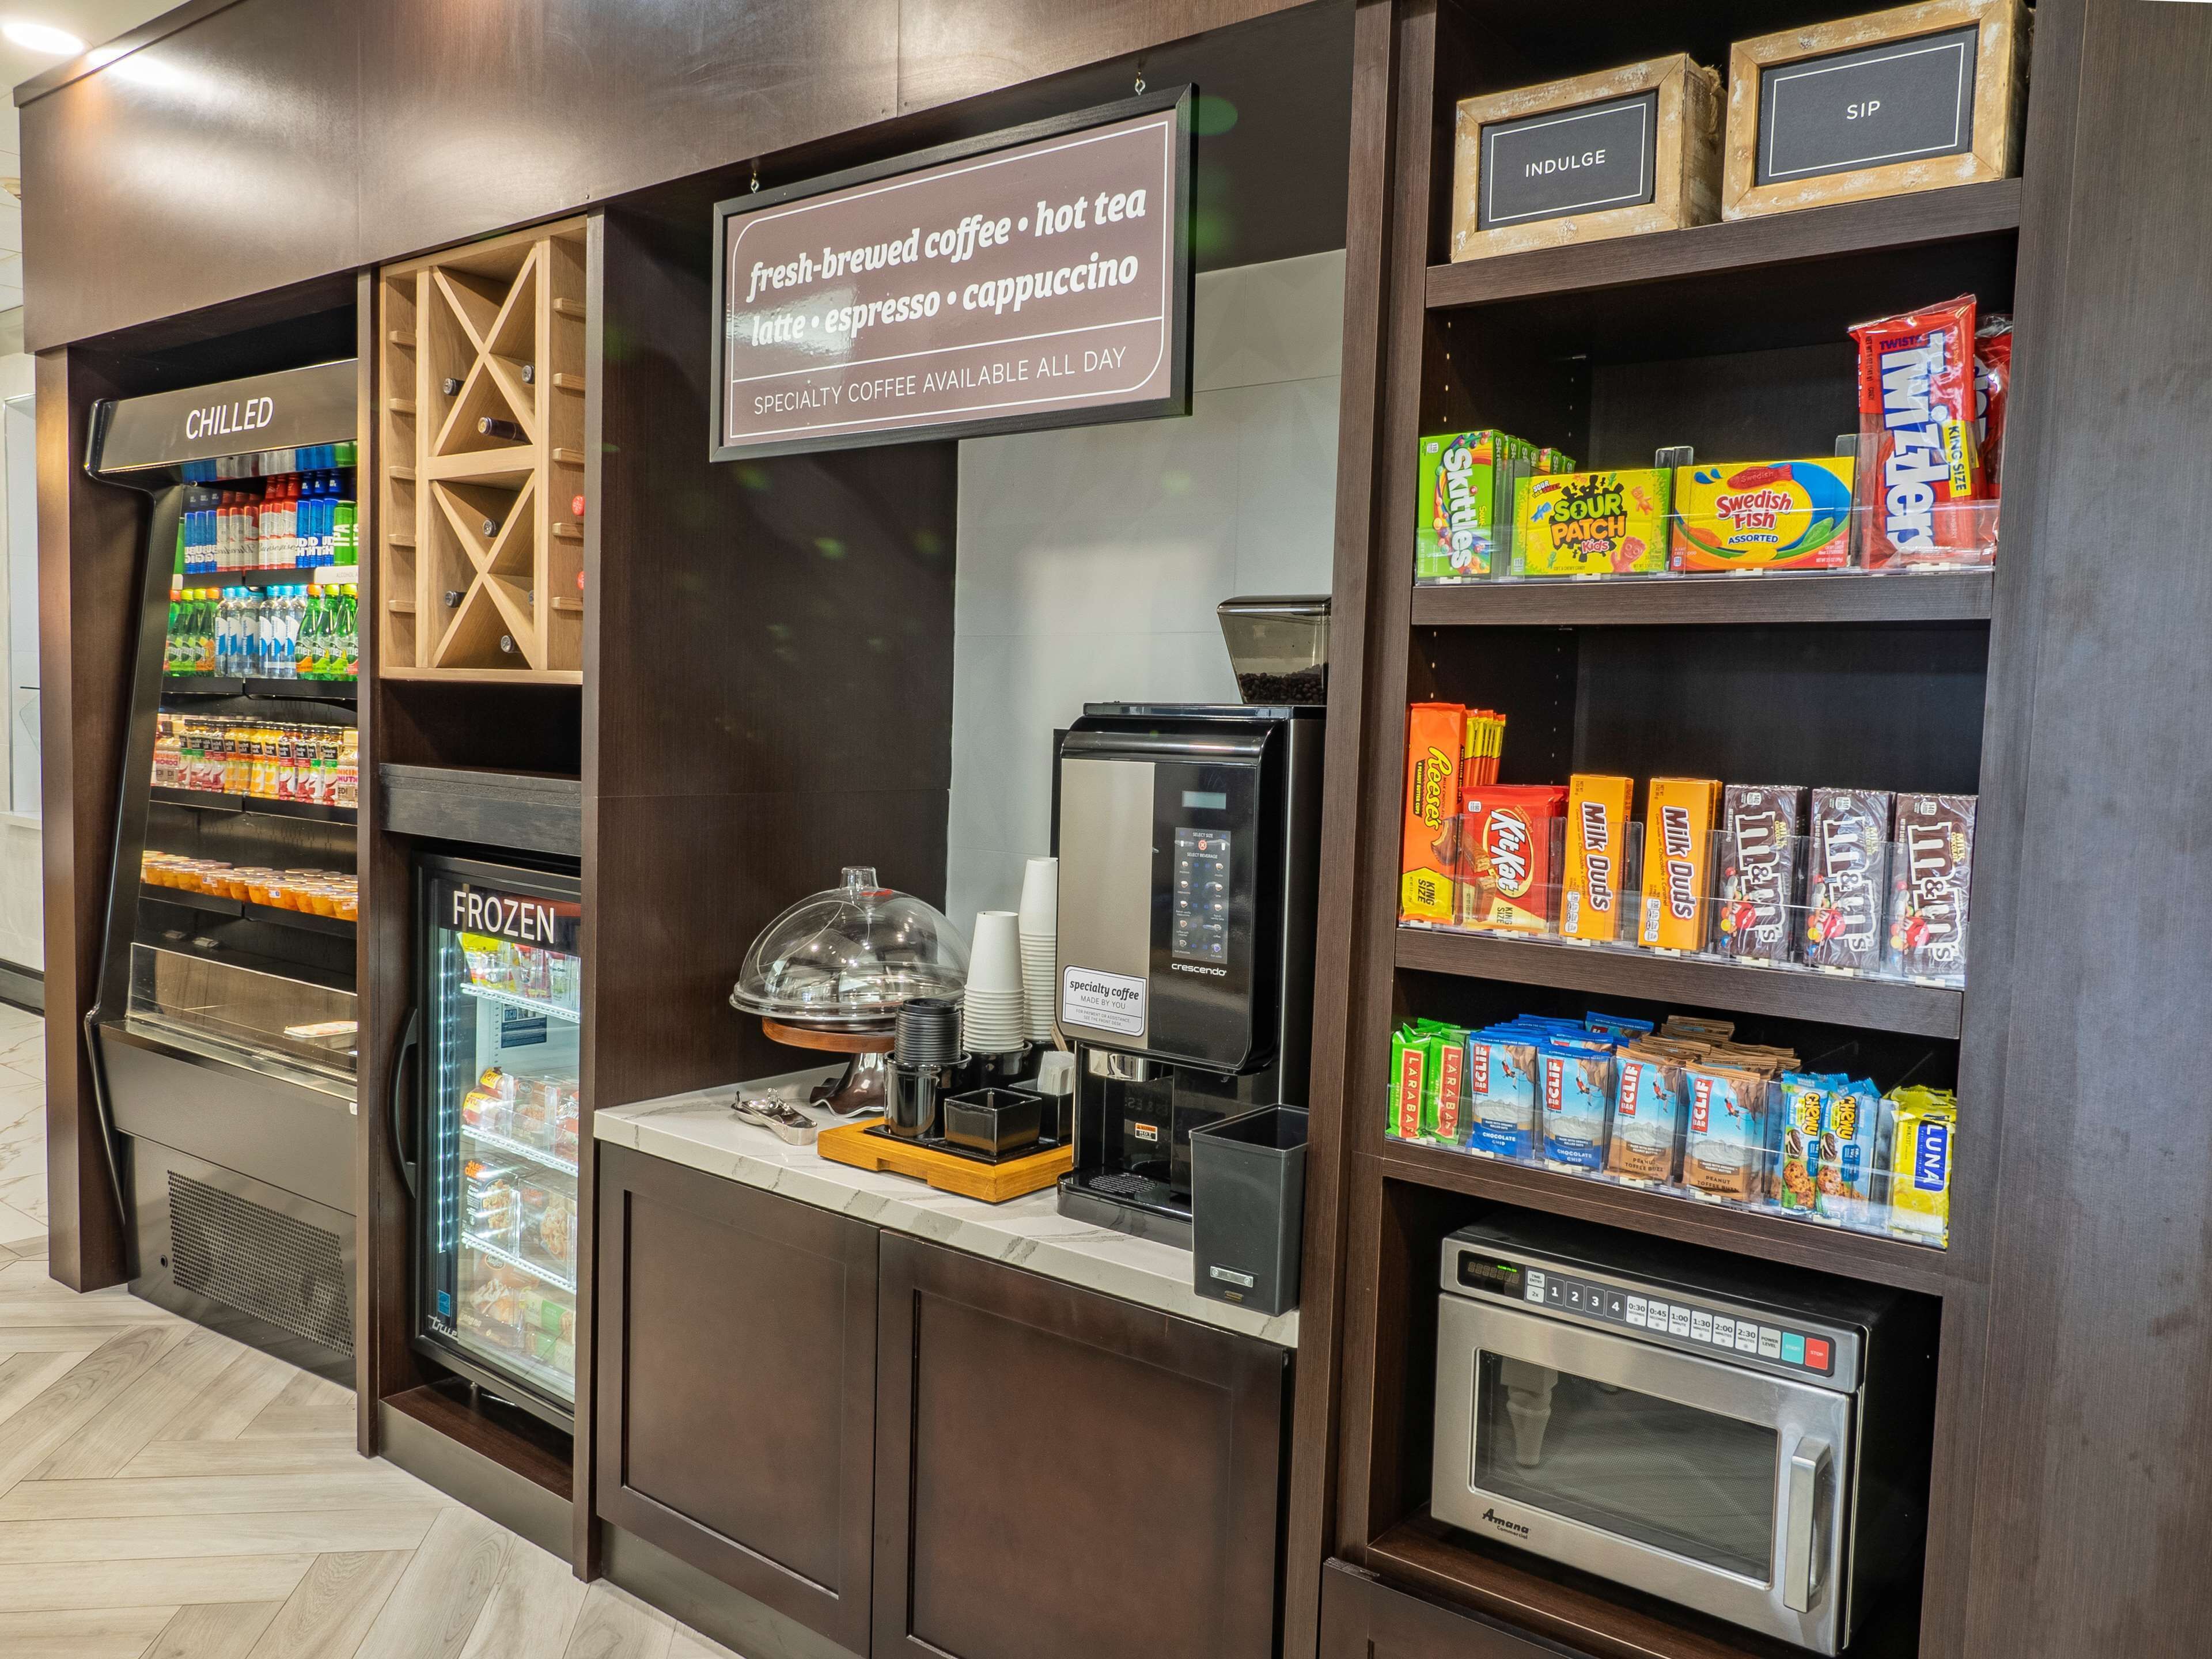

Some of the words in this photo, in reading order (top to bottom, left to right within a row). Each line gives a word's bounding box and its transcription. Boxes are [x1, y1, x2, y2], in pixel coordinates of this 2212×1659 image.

[1846, 100, 1881, 120] SIP
[1524, 149, 1607, 177] INDULGE
[747, 228, 919, 303] fresh-brewed
[924, 214, 1012, 263] coffee
[1035, 197, 1086, 238] hot
[1094, 188, 1146, 224] tea
[752, 303, 806, 347] latte
[824, 290, 940, 341] espresso
[963, 252, 1138, 315] cappuccino
[754, 384, 842, 415] SPECIALTY
[848, 375, 916, 403] COFFEE
[923, 359, 1029, 394] AVAILABLE
[1036, 354, 1074, 378] ALL
[1084, 346, 1127, 373] DAY
[185, 396, 274, 440] CHILLED
[1949, 426, 1963, 461] KING
[1532, 479, 1550, 493] SOUR
[1740, 469, 1775, 483] Swedish
[1953, 463, 1967, 491] SIZE
[1444, 448, 1477, 569] Skittles
[1554, 493, 1622, 522] SOUR
[1716, 490, 1793, 519] Swedish
[1733, 510, 1777, 530] Fish
[334, 524, 350, 547] IPA
[1551, 515, 1626, 547] PATCH
[1728, 535, 1778, 545] ASSORTED
[1581, 539, 1609, 554] Kids
[1424, 747, 1453, 831] Reese's
[1584, 804, 1607, 850] Milk
[1665, 808, 1690, 854] Milk
[1418, 879, 1426, 903] SIZE
[1588, 856, 1612, 909] Duds
[1670, 862, 1695, 916] Duds
[1426, 881, 1435, 906] KING
[453, 890, 555, 944] FROZEN
[1497, 907, 1505, 923] SIZE
[1505, 907, 1513, 925] KING
[1171, 963, 1225, 976] crescendo
[1070, 980, 1110, 997] specialty
[1112, 987, 1139, 1001] coffee
[1081, 995, 1100, 1005] MADE
[1112, 1001, 1126, 1009] YOU
[1475, 1046, 1490, 1082] CLIF
[1548, 1060, 1563, 1099] CLIF
[1622, 1065, 1639, 1103] CLIF
[1621, 1103, 1634, 1111] BAR
[1694, 1081, 1713, 1120] CLIF
[1693, 1119, 1706, 1127] BAR
[1482, 1132, 1516, 1142] CHOCOLATE
[1556, 1149, 1592, 1158] CHOCOLATE
[1923, 1124, 1943, 1183] LUNA
[1625, 1162, 1646, 1171] TOFFEE
[1696, 1180, 1720, 1189] TOFFEE
[1706, 1175, 1730, 1185] PEANUT
[1551, 1287, 1559, 1297] 1
[1571, 1291, 1579, 1302] 2
[1592, 1296, 1599, 1307] 3
[1612, 1301, 1620, 1312] 4
[1628, 1303, 1646, 1313] 0:30
[1649, 1308, 1667, 1318] 0:45
[1671, 1313, 1688, 1323] 1:00
[1693, 1318, 1711, 1328] 1:30
[427, 1315, 460, 1342] true
[1715, 1323, 1733, 1334] 2:00
[1737, 1328, 1756, 1339] 2:30
[1760, 1336, 1779, 1344] POWER
[1482, 1508, 1530, 1535] Amana
[1497, 1525, 1528, 1540] Commercial
